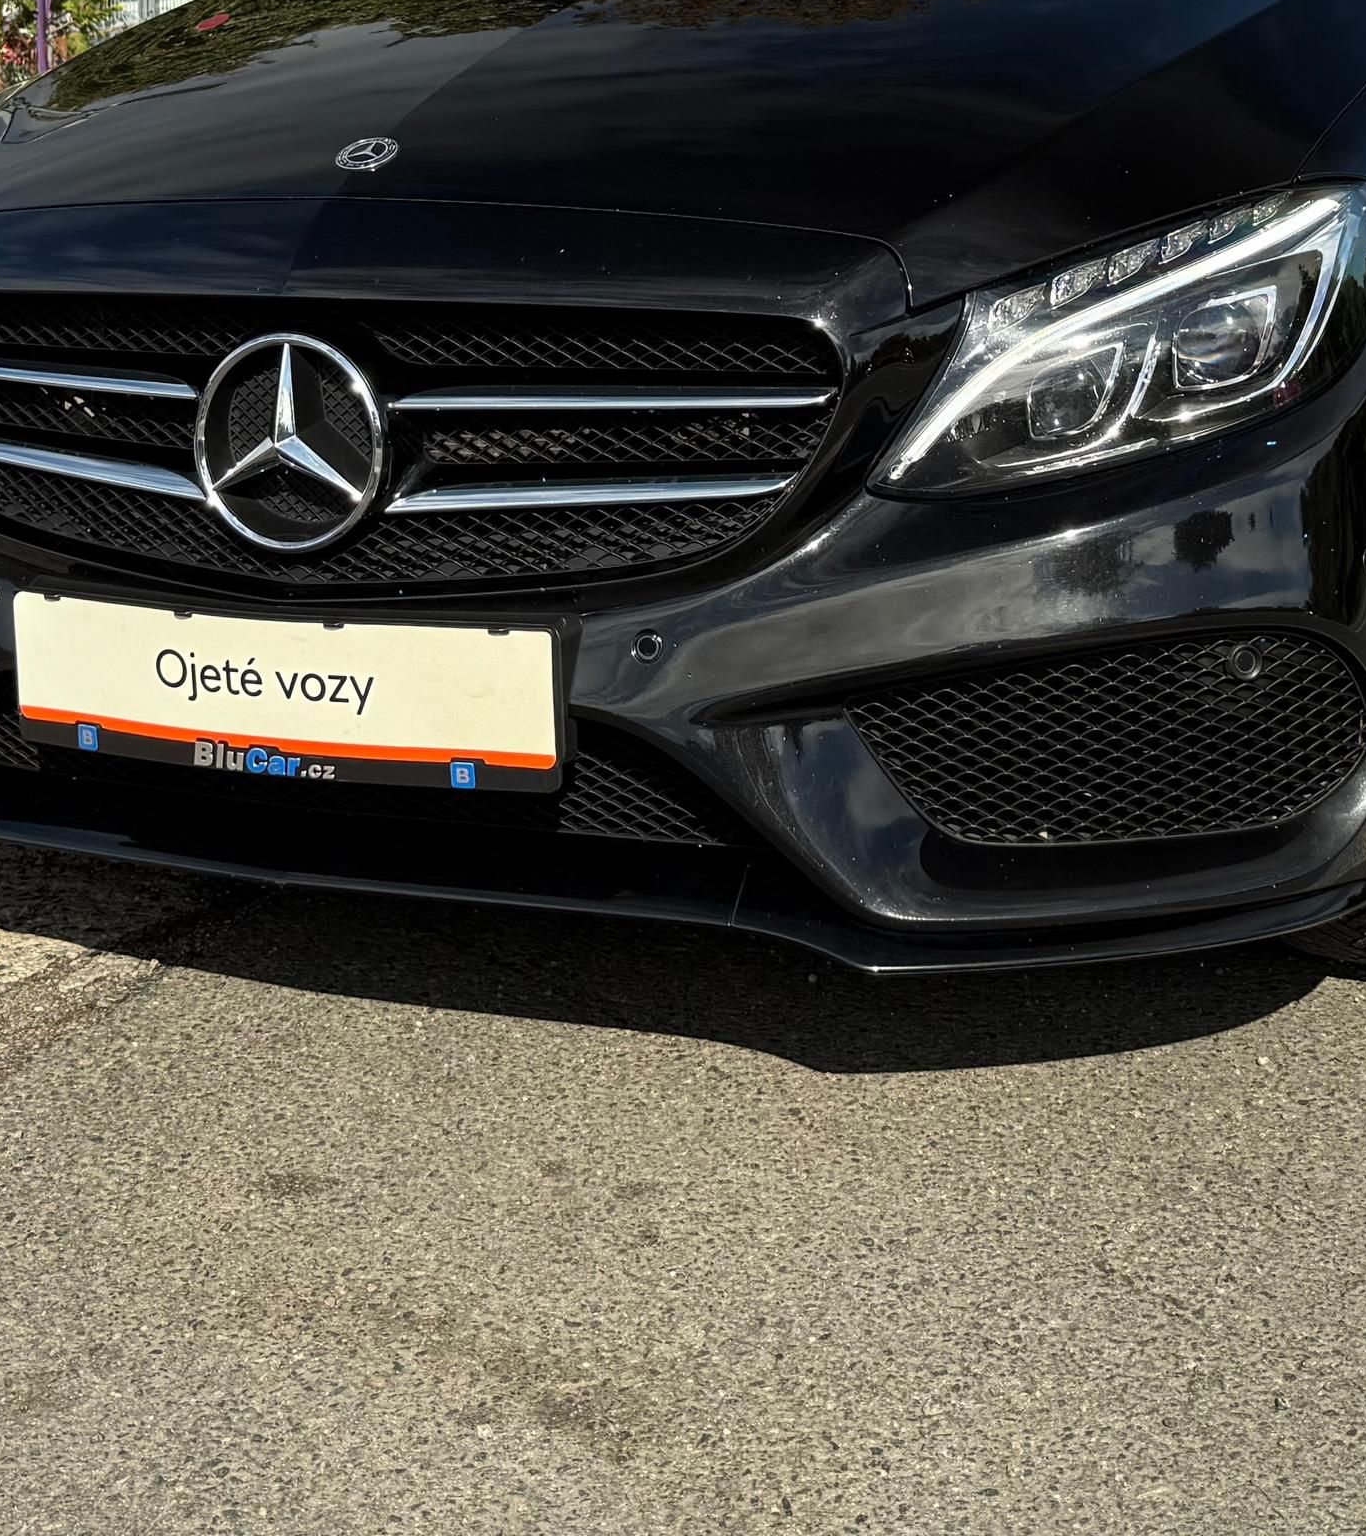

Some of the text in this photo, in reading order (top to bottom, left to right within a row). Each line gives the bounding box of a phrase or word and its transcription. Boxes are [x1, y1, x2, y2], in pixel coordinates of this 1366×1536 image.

[155, 648, 374, 715] Ojeté vozy
[193, 740, 335, 780] BluCar.cz
[456, 767, 470, 784] B
